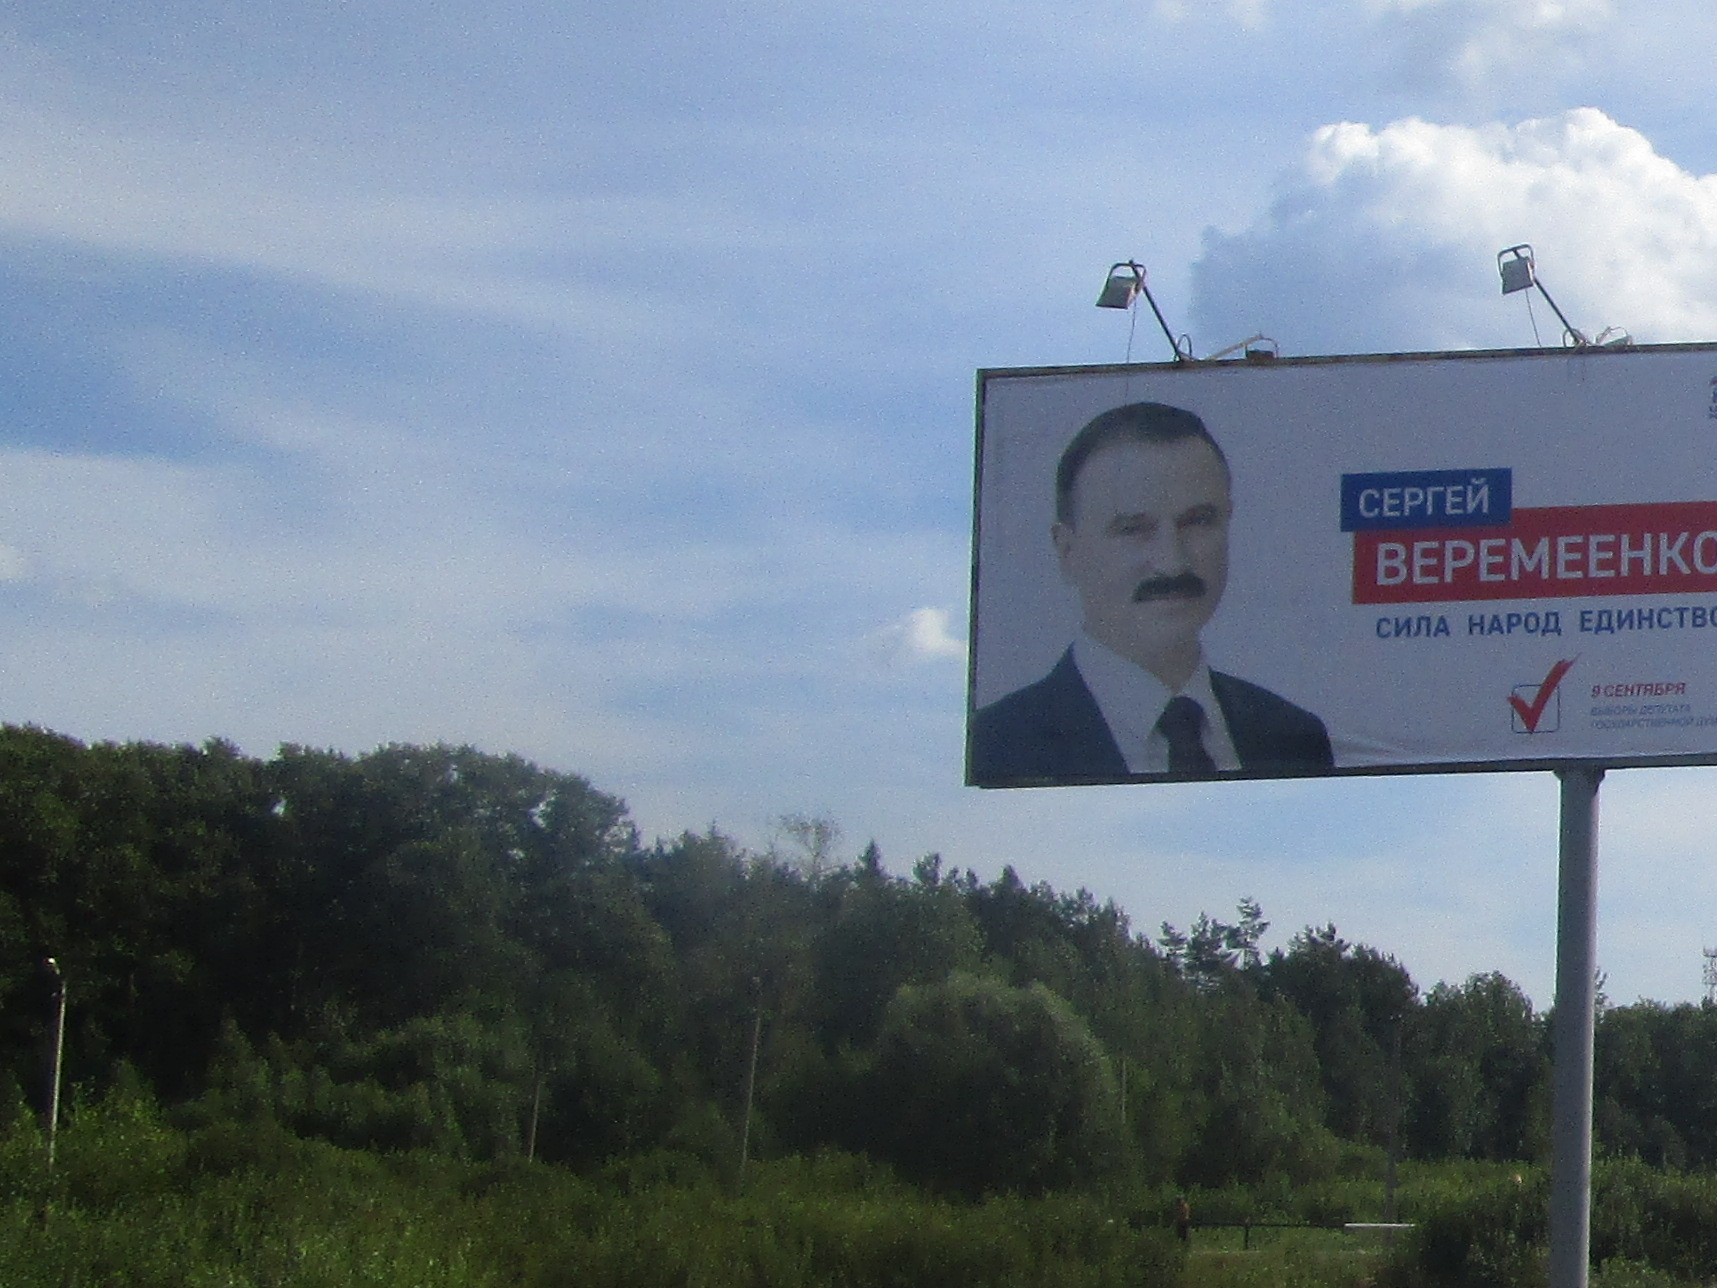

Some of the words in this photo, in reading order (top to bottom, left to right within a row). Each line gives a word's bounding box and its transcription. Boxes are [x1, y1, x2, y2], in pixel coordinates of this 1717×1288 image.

[1358, 478, 1490, 518] СЕРГЕЙ
[1375, 615, 1451, 639] СИЛА
[1468, 611, 1562, 637] НАРОД
[1591, 685, 1601, 698] 9
[1604, 682, 1686, 698] СЕНТЯБРЯ
